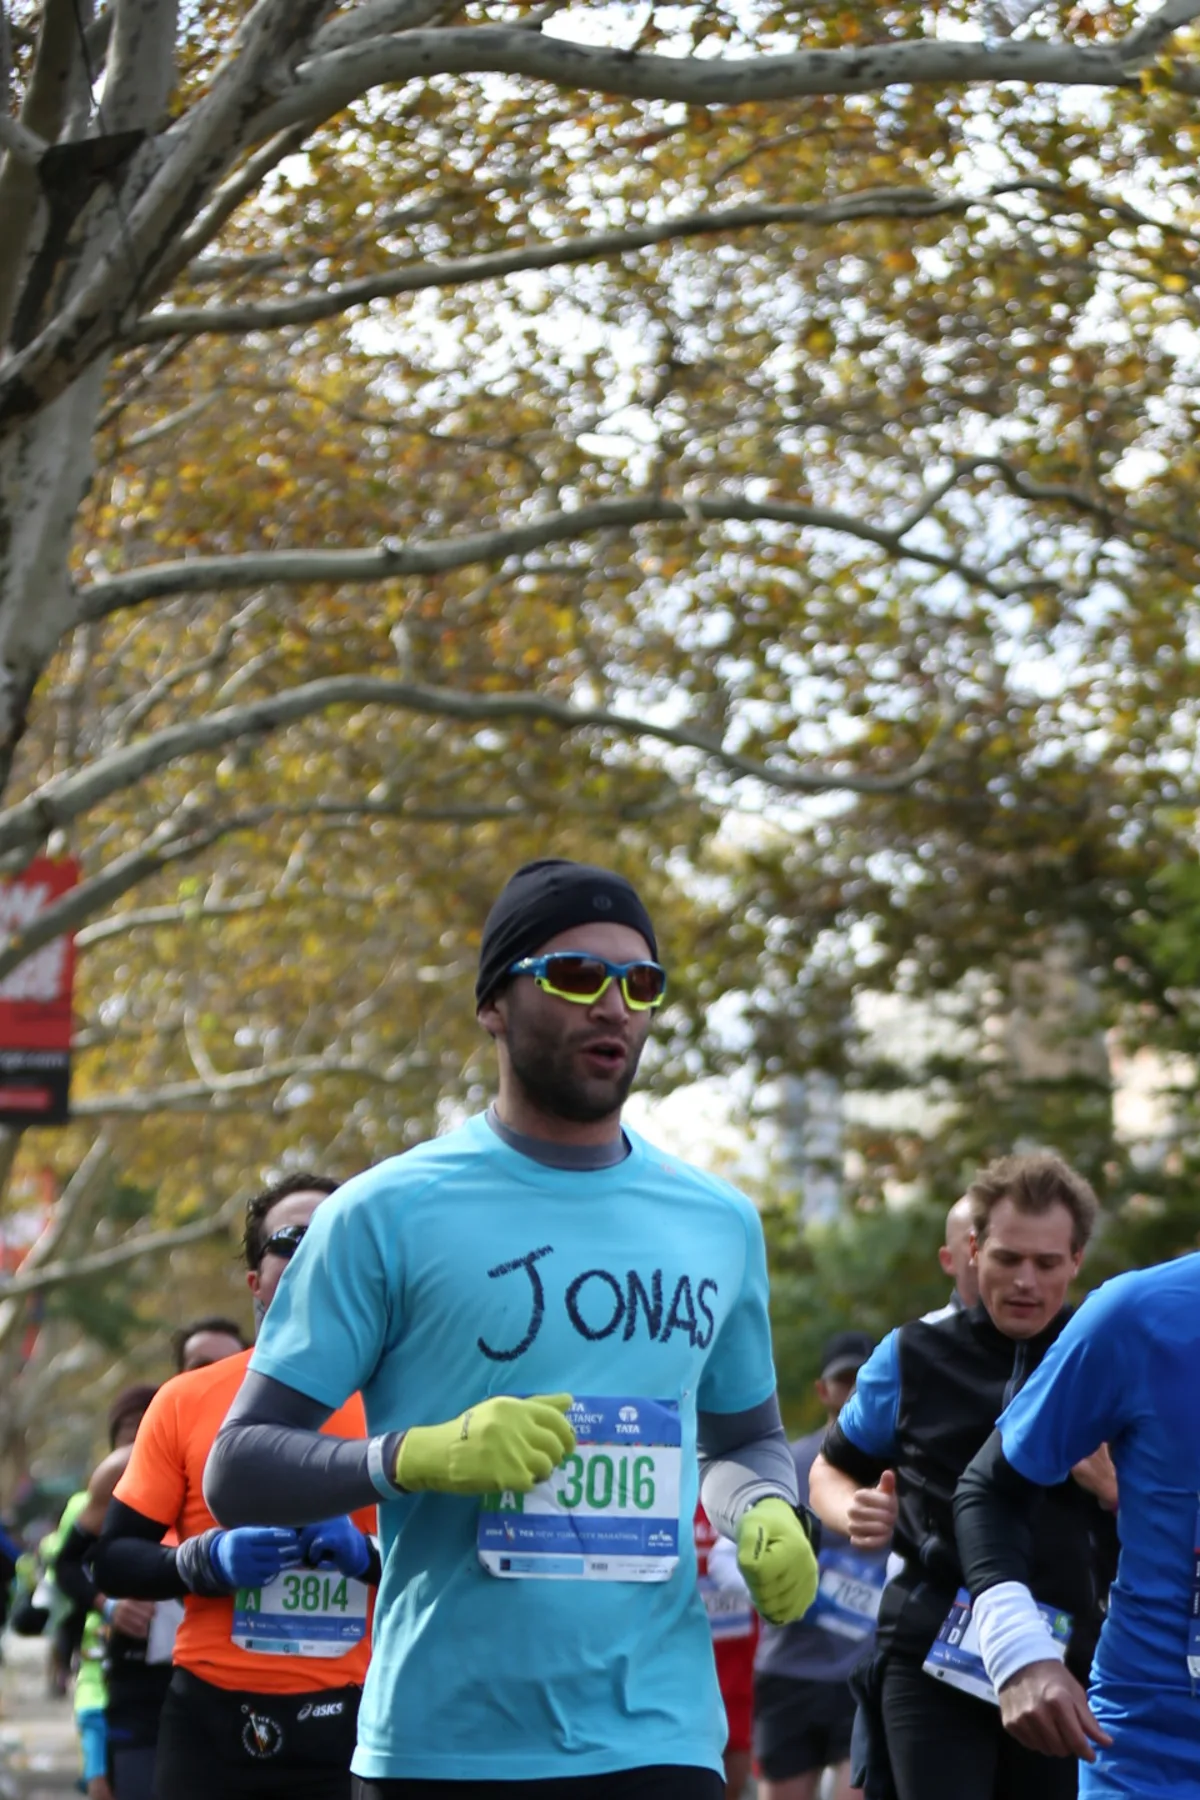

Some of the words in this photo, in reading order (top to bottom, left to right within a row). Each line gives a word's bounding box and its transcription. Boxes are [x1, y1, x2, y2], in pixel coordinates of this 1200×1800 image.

[477, 1245, 717, 1361] JONAS
[615, 1424, 640, 1433] TATA
[557, 1454, 655, 1509] 3016
[245, 1592, 256, 1611] A
[282, 1574, 348, 1612] 3814
[947, 1627, 961, 1645] D
[311, 1701, 343, 1717] asics
